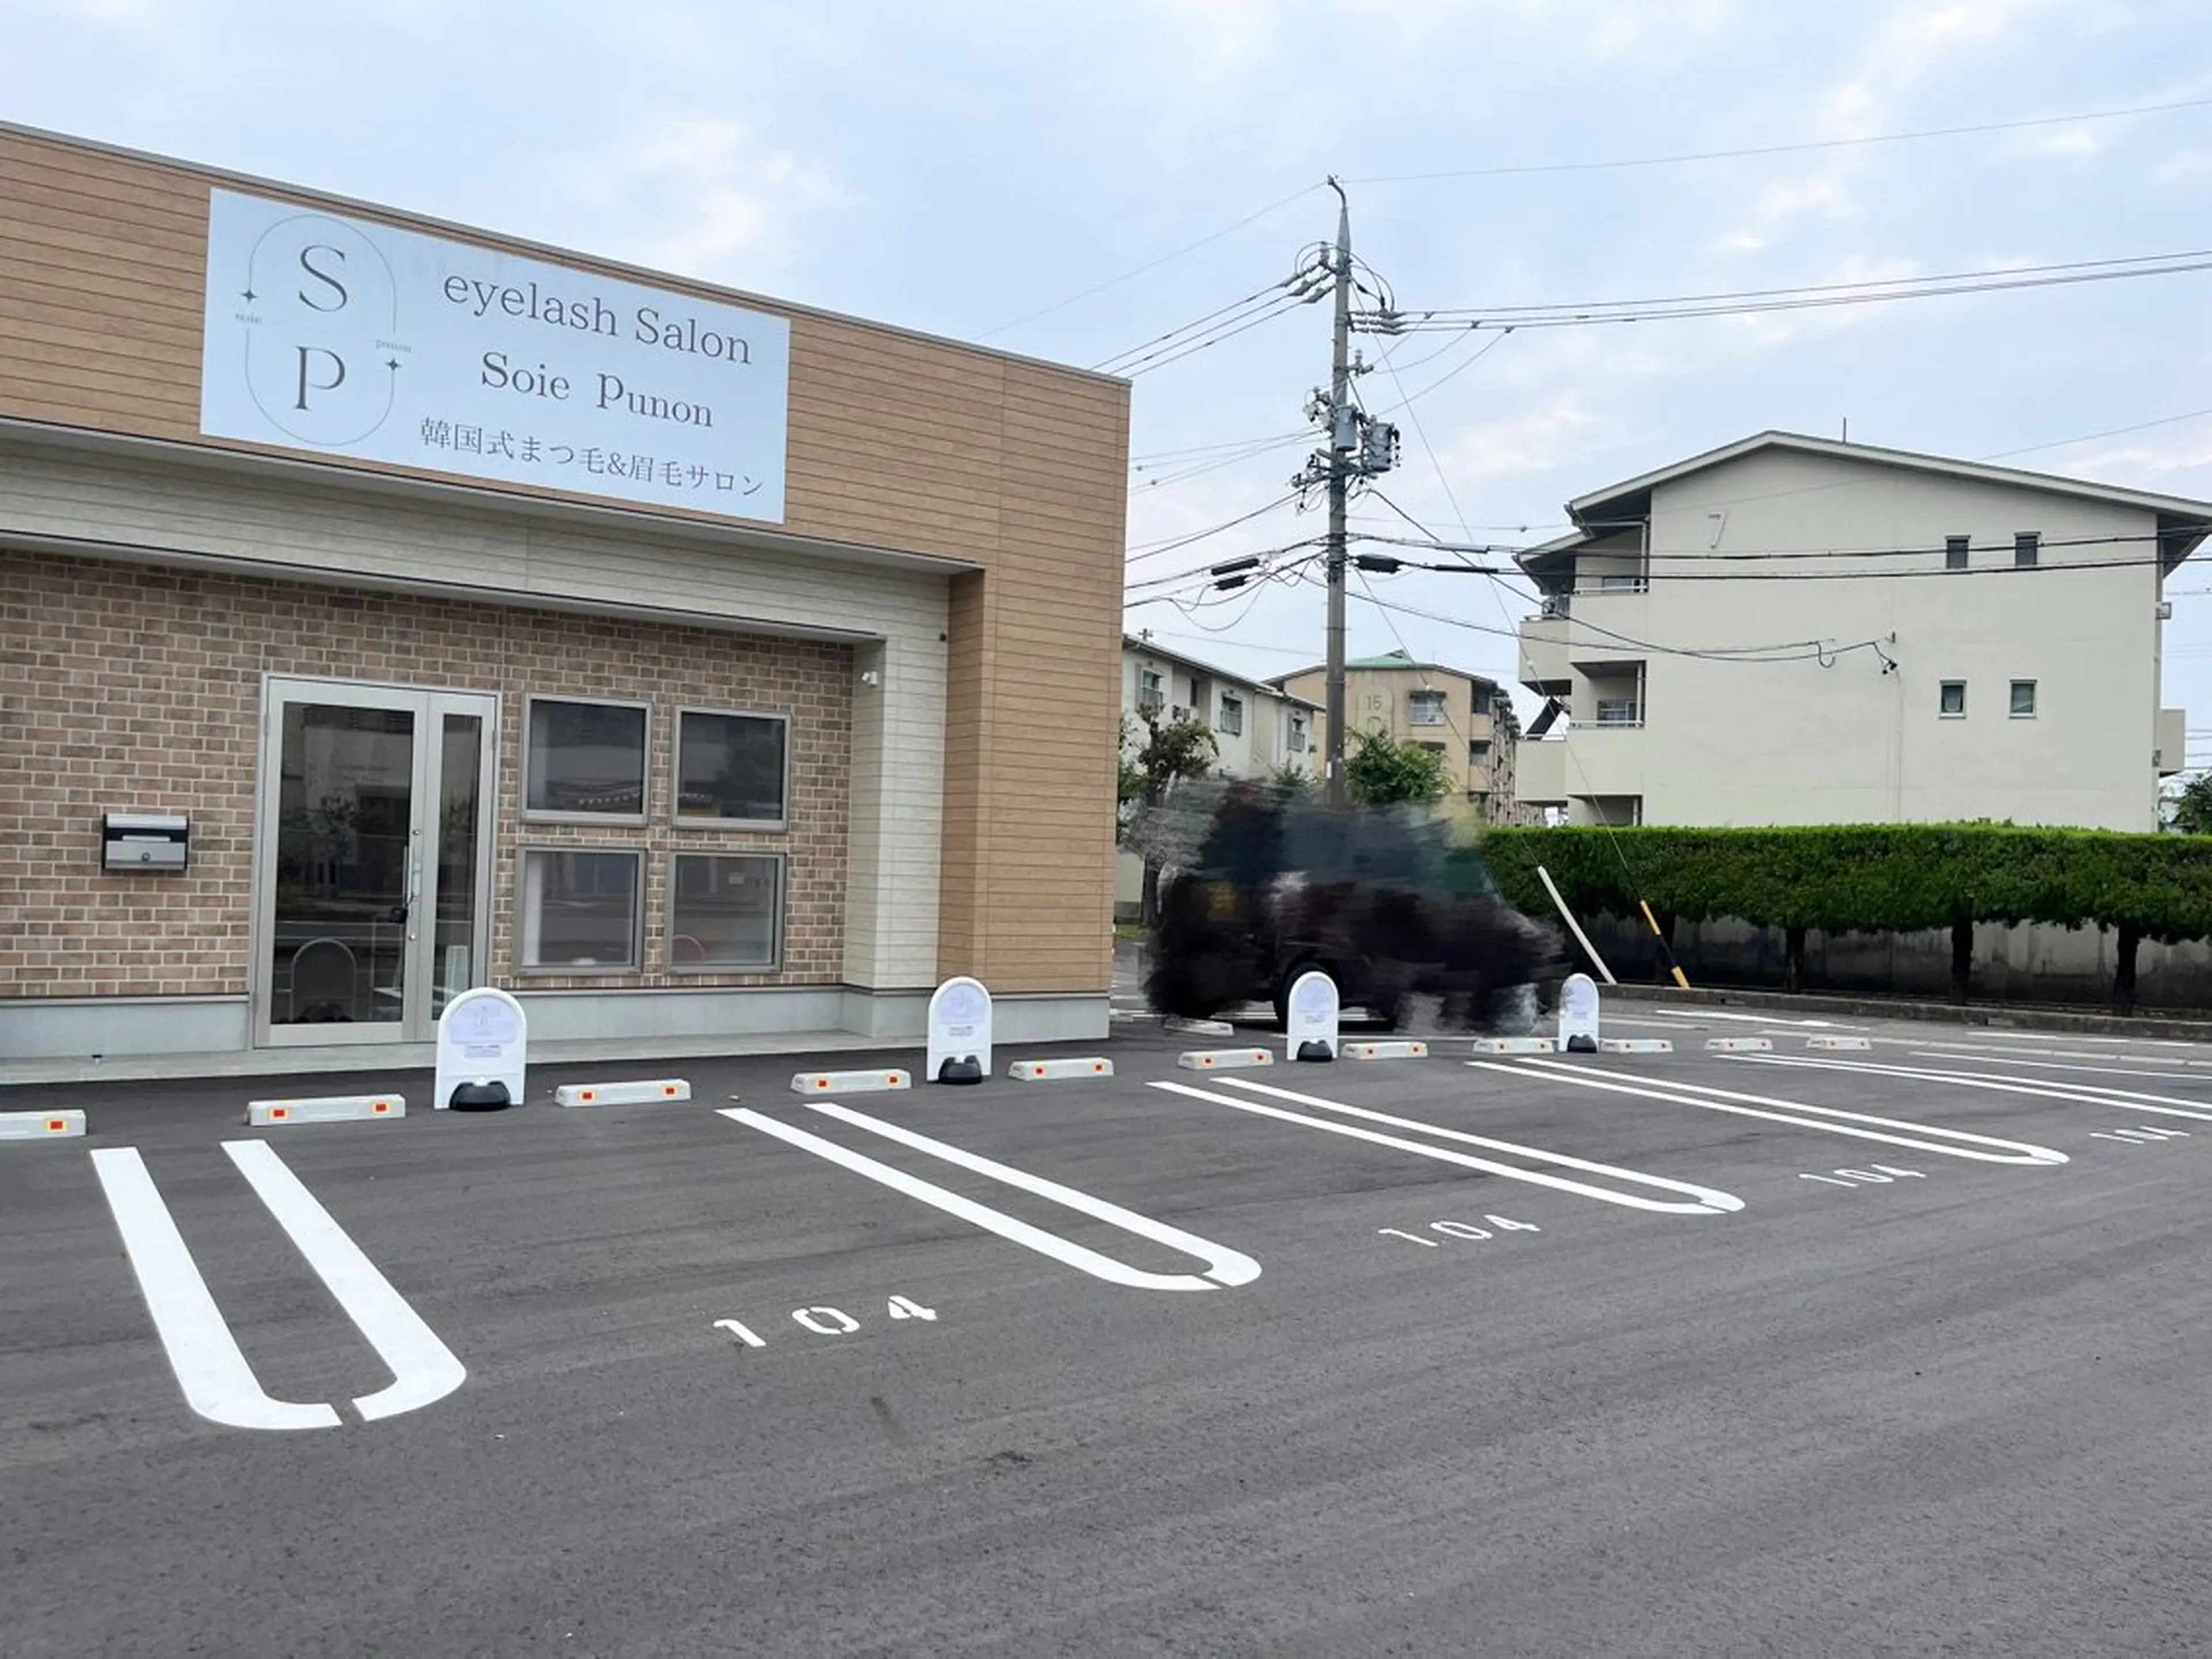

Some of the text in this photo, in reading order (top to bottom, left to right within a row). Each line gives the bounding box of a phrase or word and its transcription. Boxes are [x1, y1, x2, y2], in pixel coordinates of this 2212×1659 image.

[299, 244, 347, 312] S
[444, 274, 752, 365] eyelash Salon
[295, 346, 346, 411] P
[482, 351, 713, 427] Soie Punon
[421, 416, 763, 497] 韓国式まつ毛&眉毛サロン
[1366, 695, 1384, 711] 15
[1798, 1164, 1927, 1188] 104
[1378, 1214, 1541, 1247] 104
[713, 1295, 938, 1347] 104
